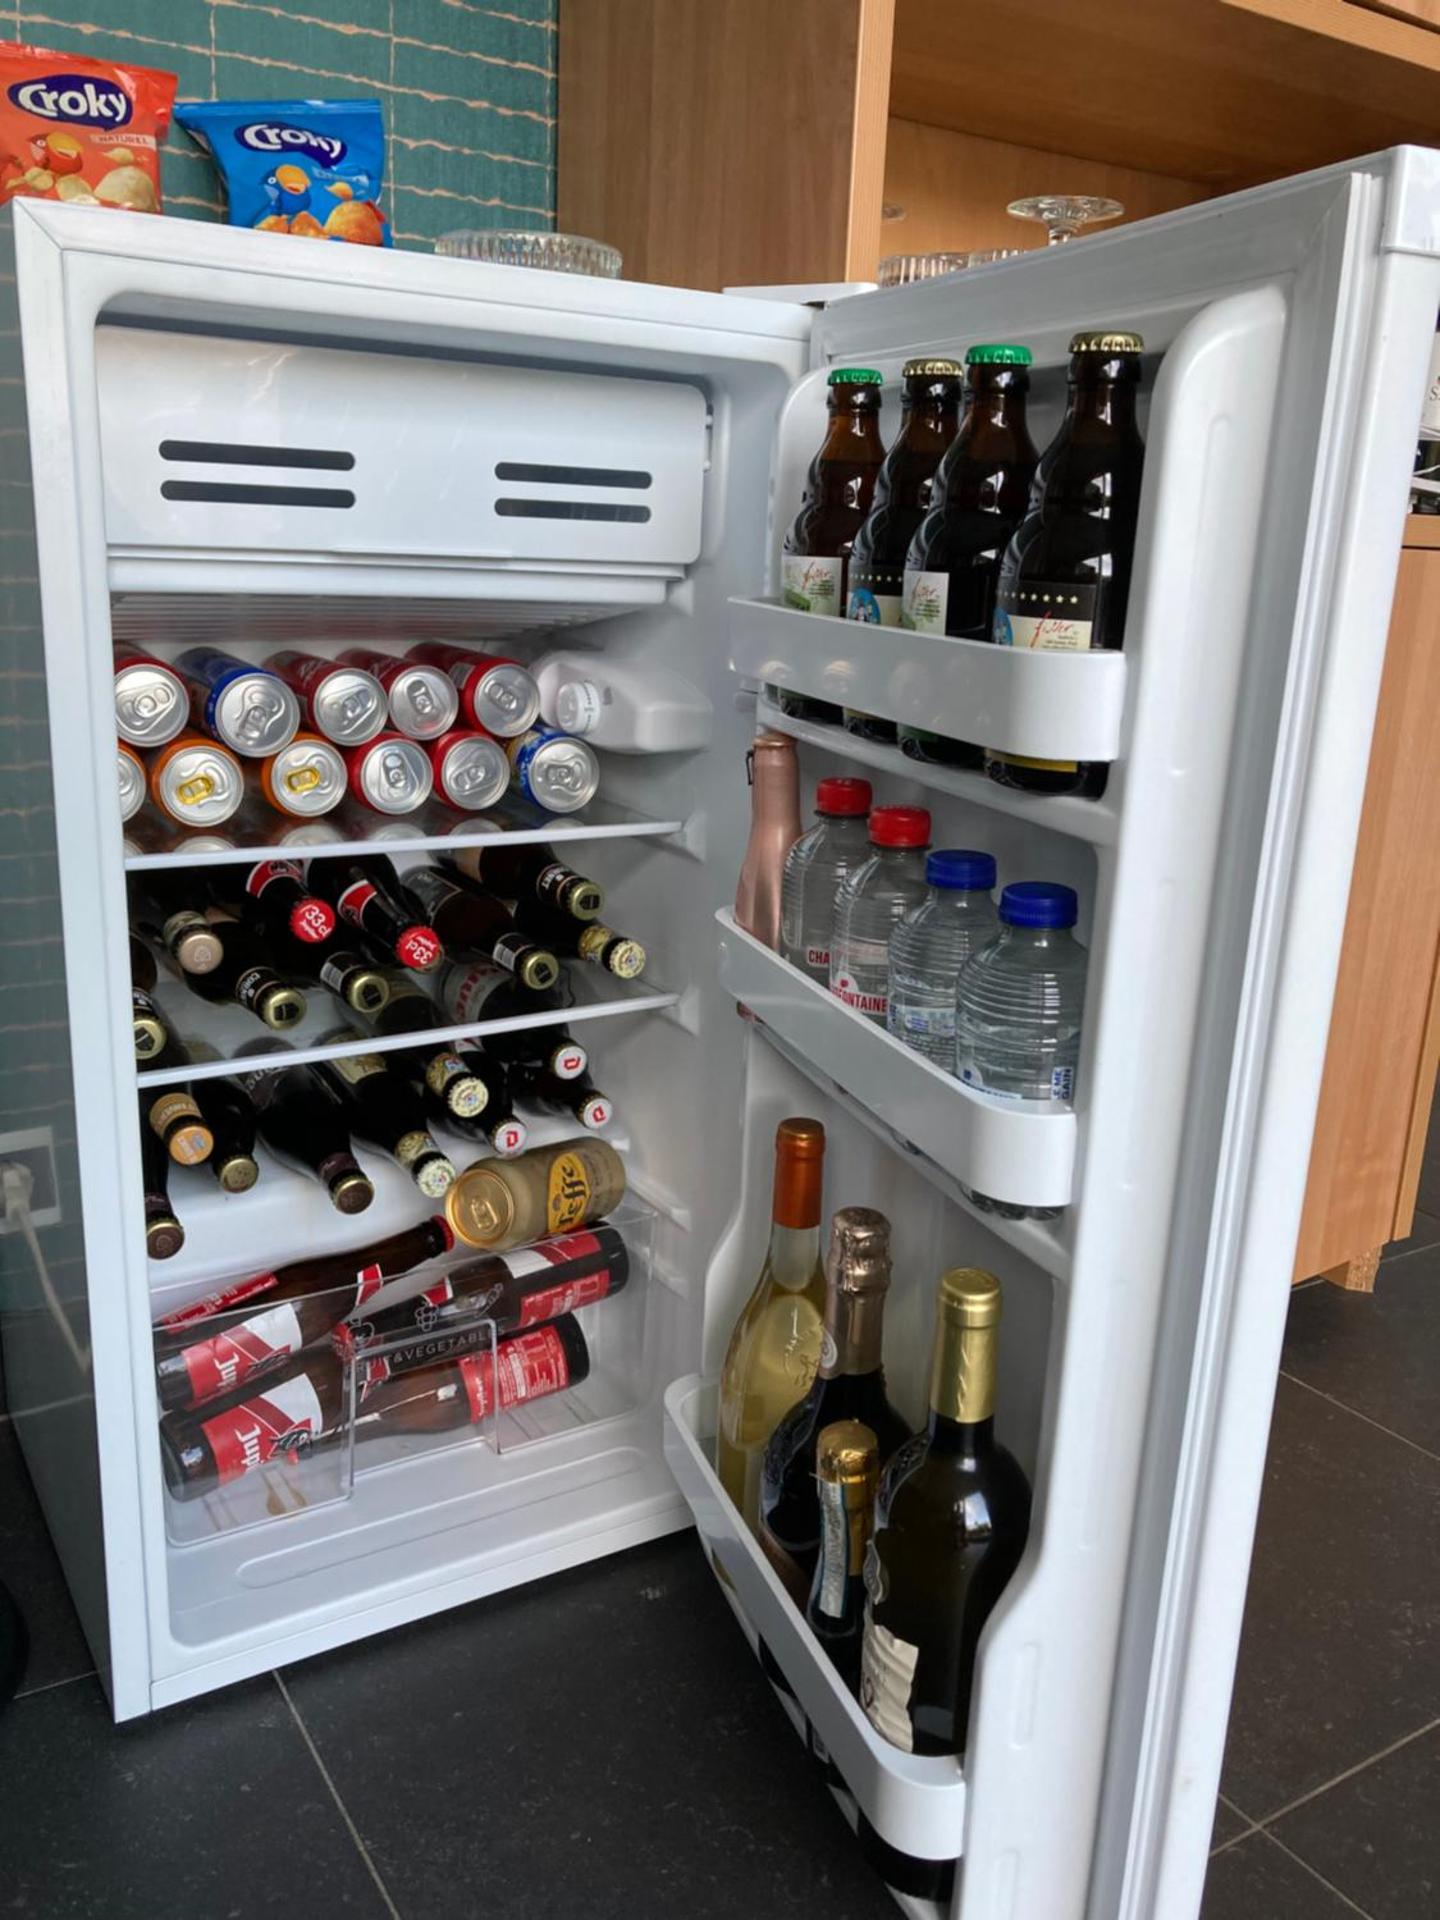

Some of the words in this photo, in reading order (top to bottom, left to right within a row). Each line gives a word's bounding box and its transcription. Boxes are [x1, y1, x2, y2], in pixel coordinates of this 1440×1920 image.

[18, 83, 127, 122] Croky
[243, 124, 342, 158] Croky
[557, 1164, 588, 1225] Leffe
